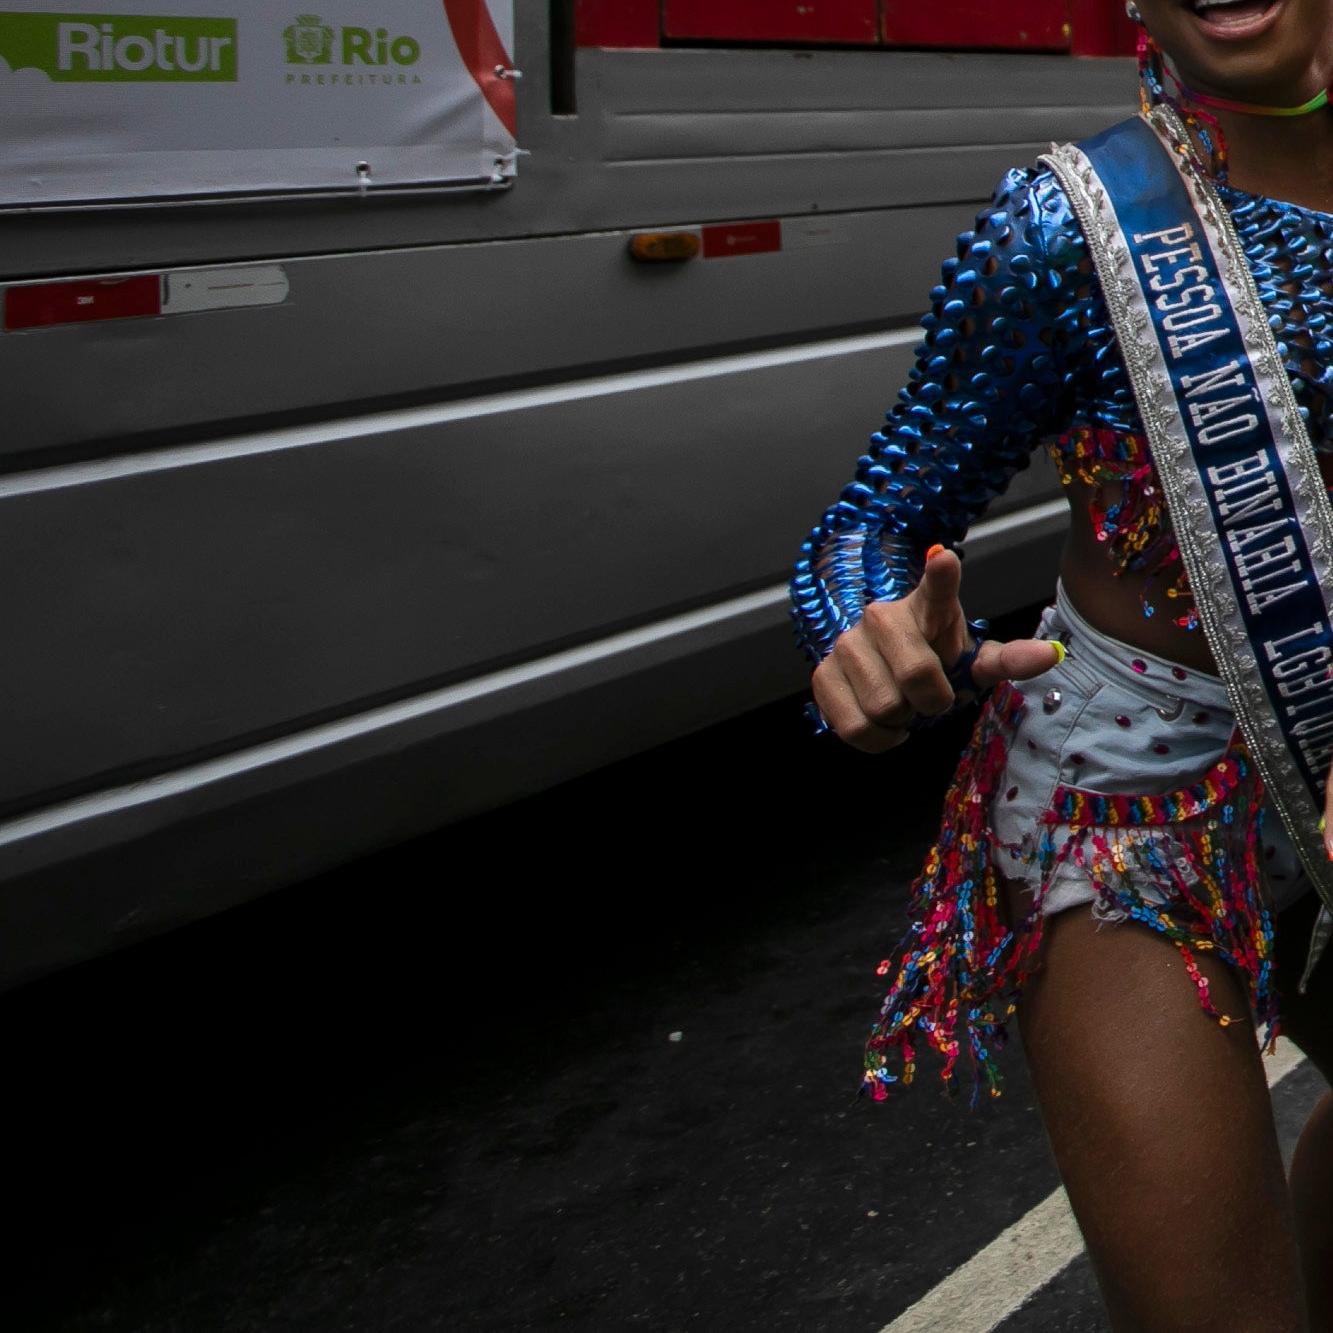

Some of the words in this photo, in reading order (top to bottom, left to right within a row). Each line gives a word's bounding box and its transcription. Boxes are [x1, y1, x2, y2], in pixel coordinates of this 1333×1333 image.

[57, 22, 232, 72] Riotur
[285, 73, 422, 86] PREFEITURA
[342, 26, 421, 67] Rio
[1132, 222, 1231, 360] PESSOA
[1180, 359, 1262, 448] NÃO
[1206, 448, 1310, 616] BINÁRIA
